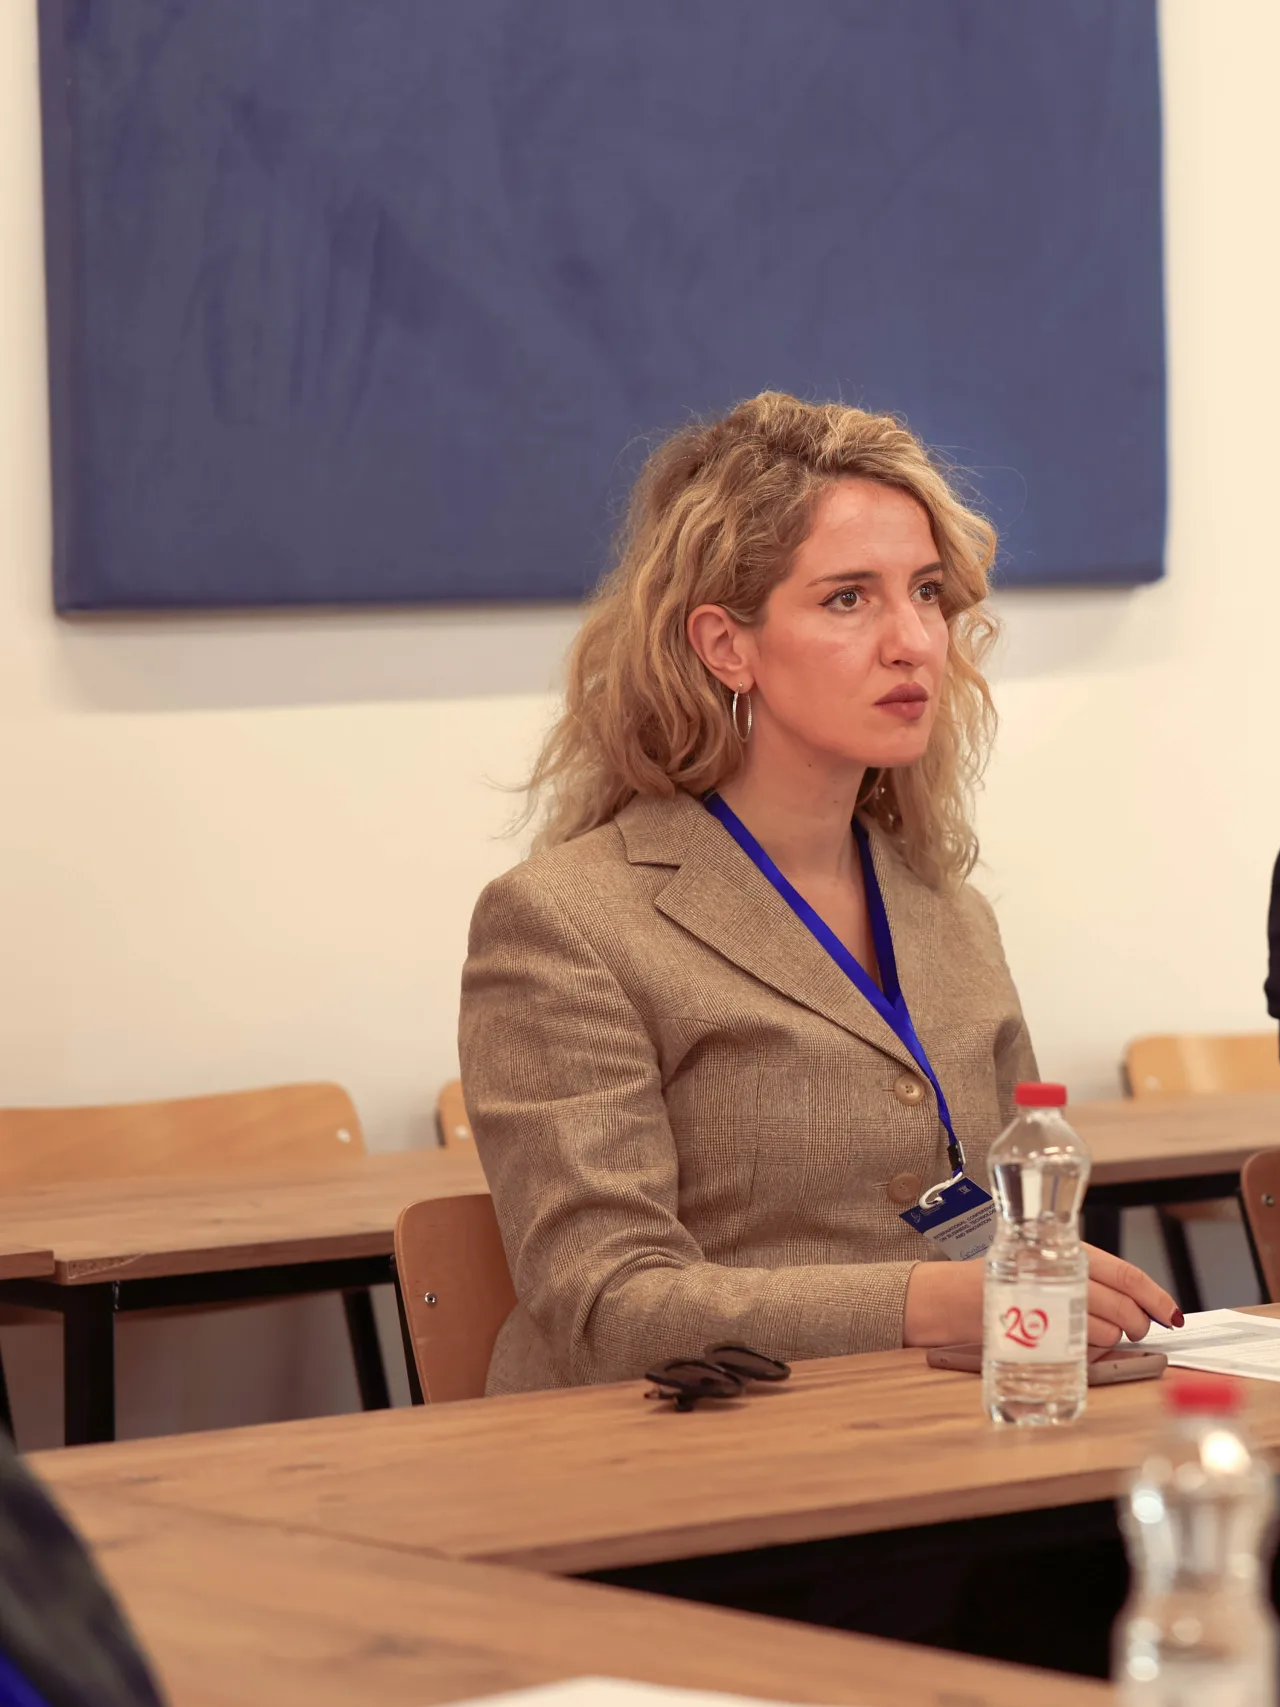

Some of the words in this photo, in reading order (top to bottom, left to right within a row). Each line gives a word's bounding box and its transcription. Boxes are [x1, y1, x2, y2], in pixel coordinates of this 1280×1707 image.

[969, 1207, 996, 1225] TECHNOLOG
[933, 1218, 967, 1240] INTERNATIONAL
[1004, 1305, 1049, 1349] 20
